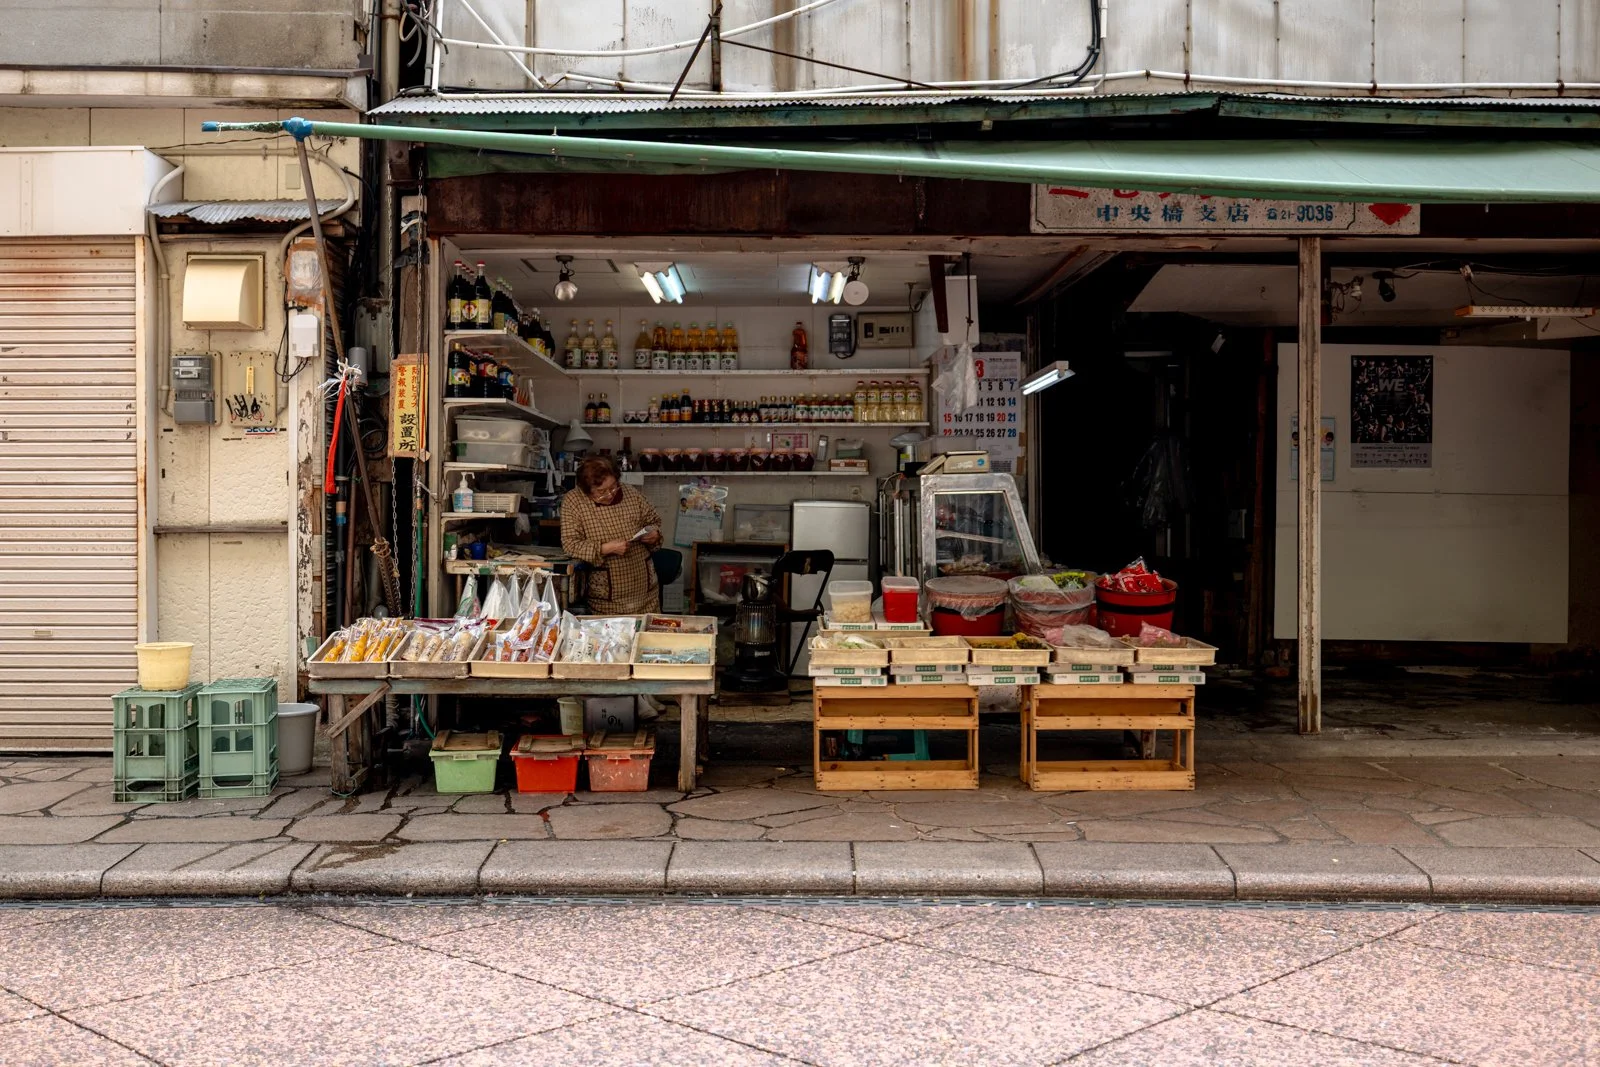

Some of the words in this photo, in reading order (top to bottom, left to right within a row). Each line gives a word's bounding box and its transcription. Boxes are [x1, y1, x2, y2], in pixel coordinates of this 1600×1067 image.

[1096, 203, 1250, 223] 中央橋支店
[975, 360, 984, 378] 3
[988, 382, 993, 391] 5
[998, 382, 1003, 391] 6
[1009, 382, 1014, 391] 7
[1379, 378, 1405, 392] WE
[986, 397, 994, 406] 12
[997, 397, 1005, 406] 13
[1008, 397, 1016, 406] 14
[943, 413, 952, 422] 15
[954, 413, 962, 422] 16
[965, 413, 973, 422] 17
[976, 413, 984, 422] 18
[986, 413, 994, 422] 19
[997, 413, 1005, 422] 20
[1008, 413, 1016, 422] 21
[399, 413, 416, 451] 設置所
[976, 429, 984, 437] 25
[986, 429, 995, 437] 26
[997, 429, 1006, 437] 27
[1008, 429, 1016, 437] 28
